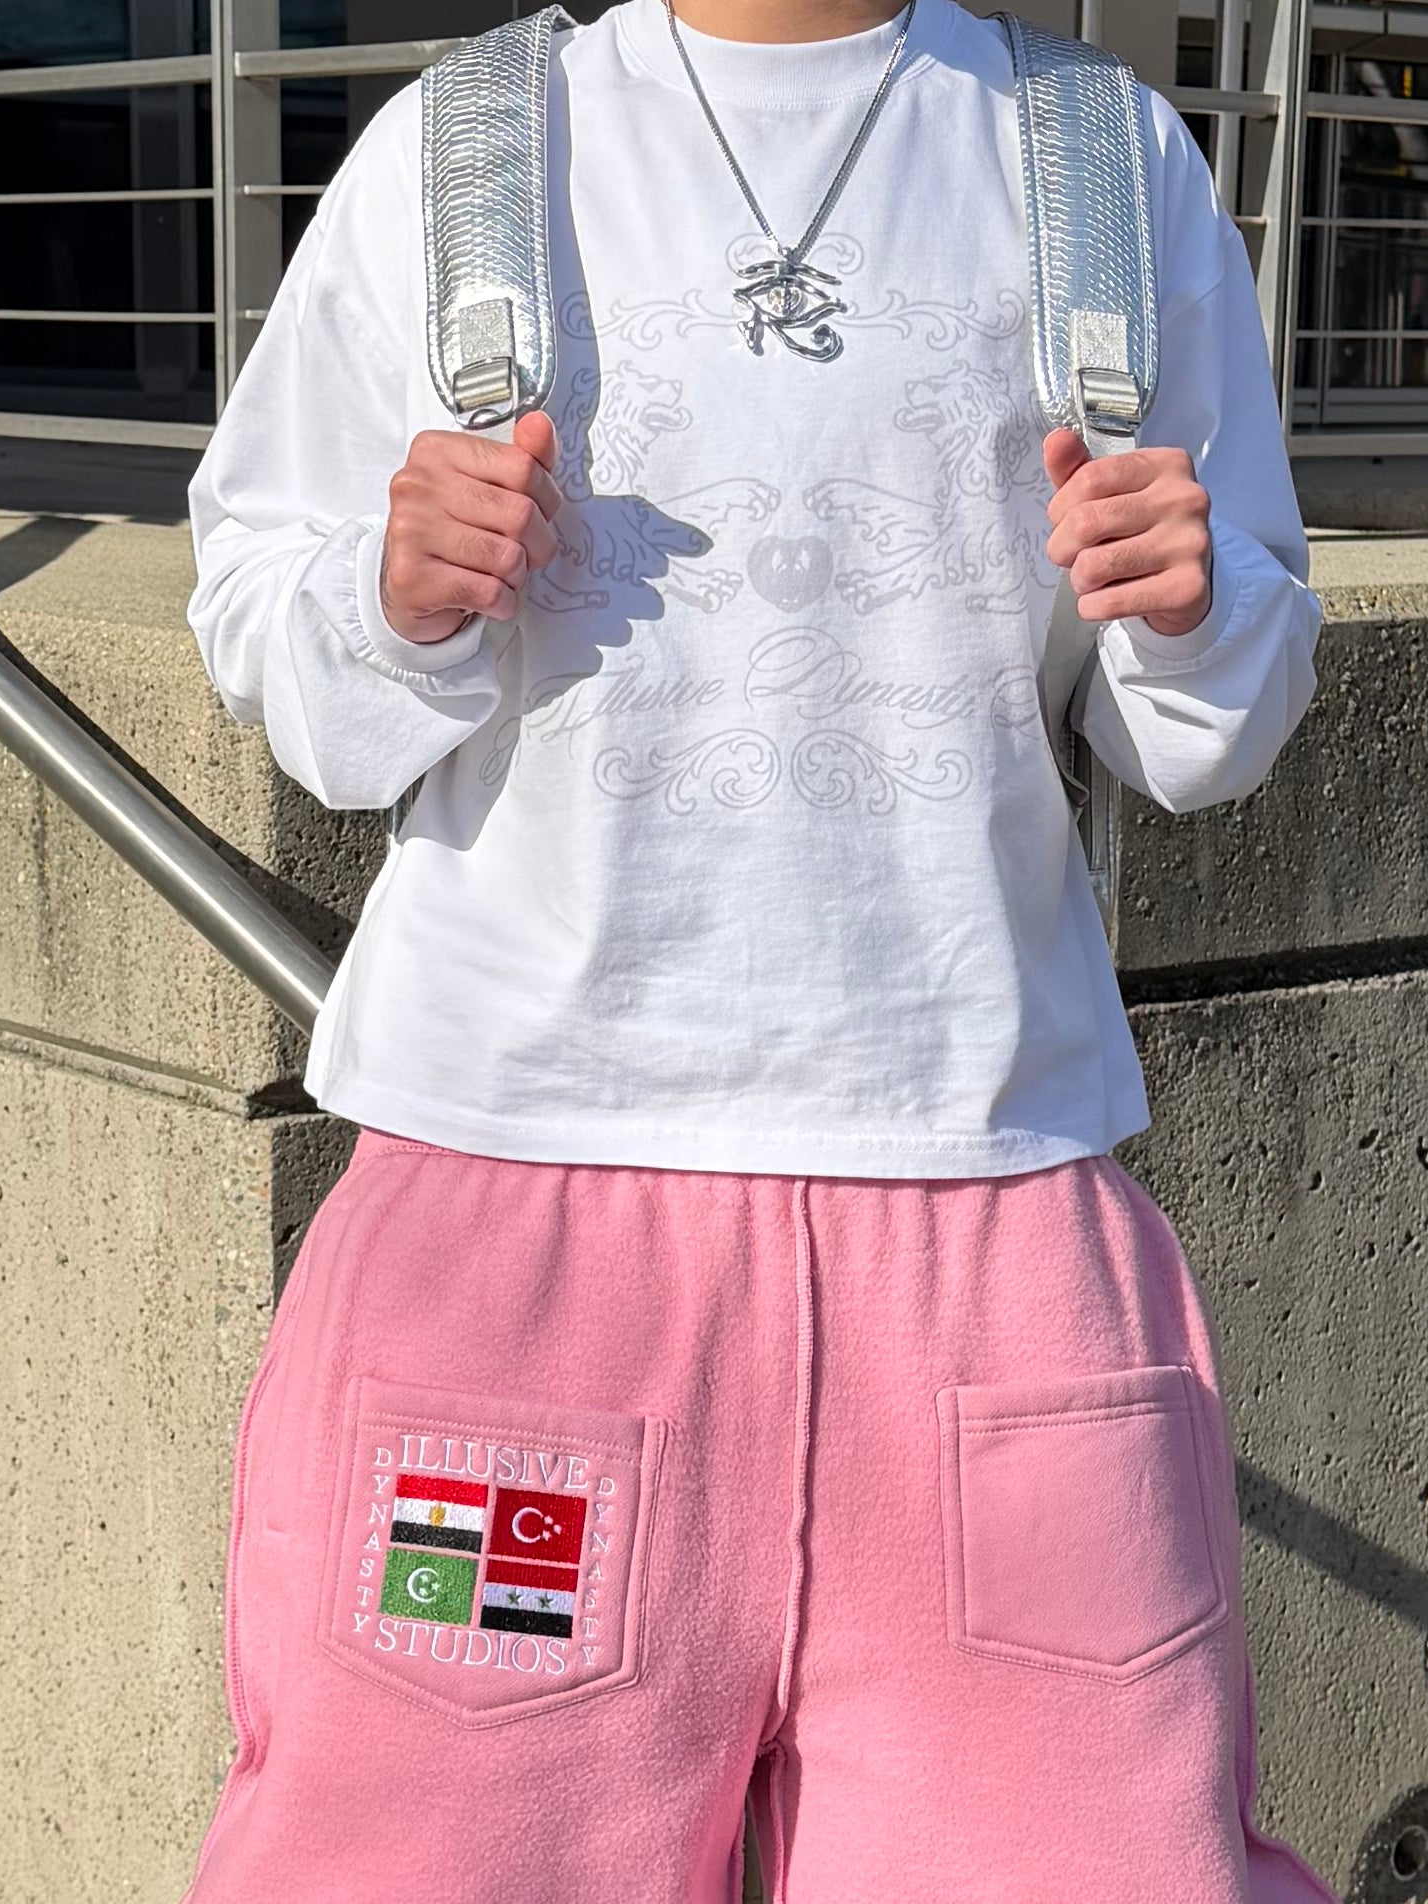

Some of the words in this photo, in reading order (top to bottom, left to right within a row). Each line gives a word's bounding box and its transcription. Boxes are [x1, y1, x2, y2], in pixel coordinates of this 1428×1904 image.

[397, 1433, 590, 1491] ILLUSIVE
[352, 1446, 393, 1634] DYNASTY
[580, 1476, 617, 1667] DYNASTY
[373, 1616, 568, 1676] STUDIOS
